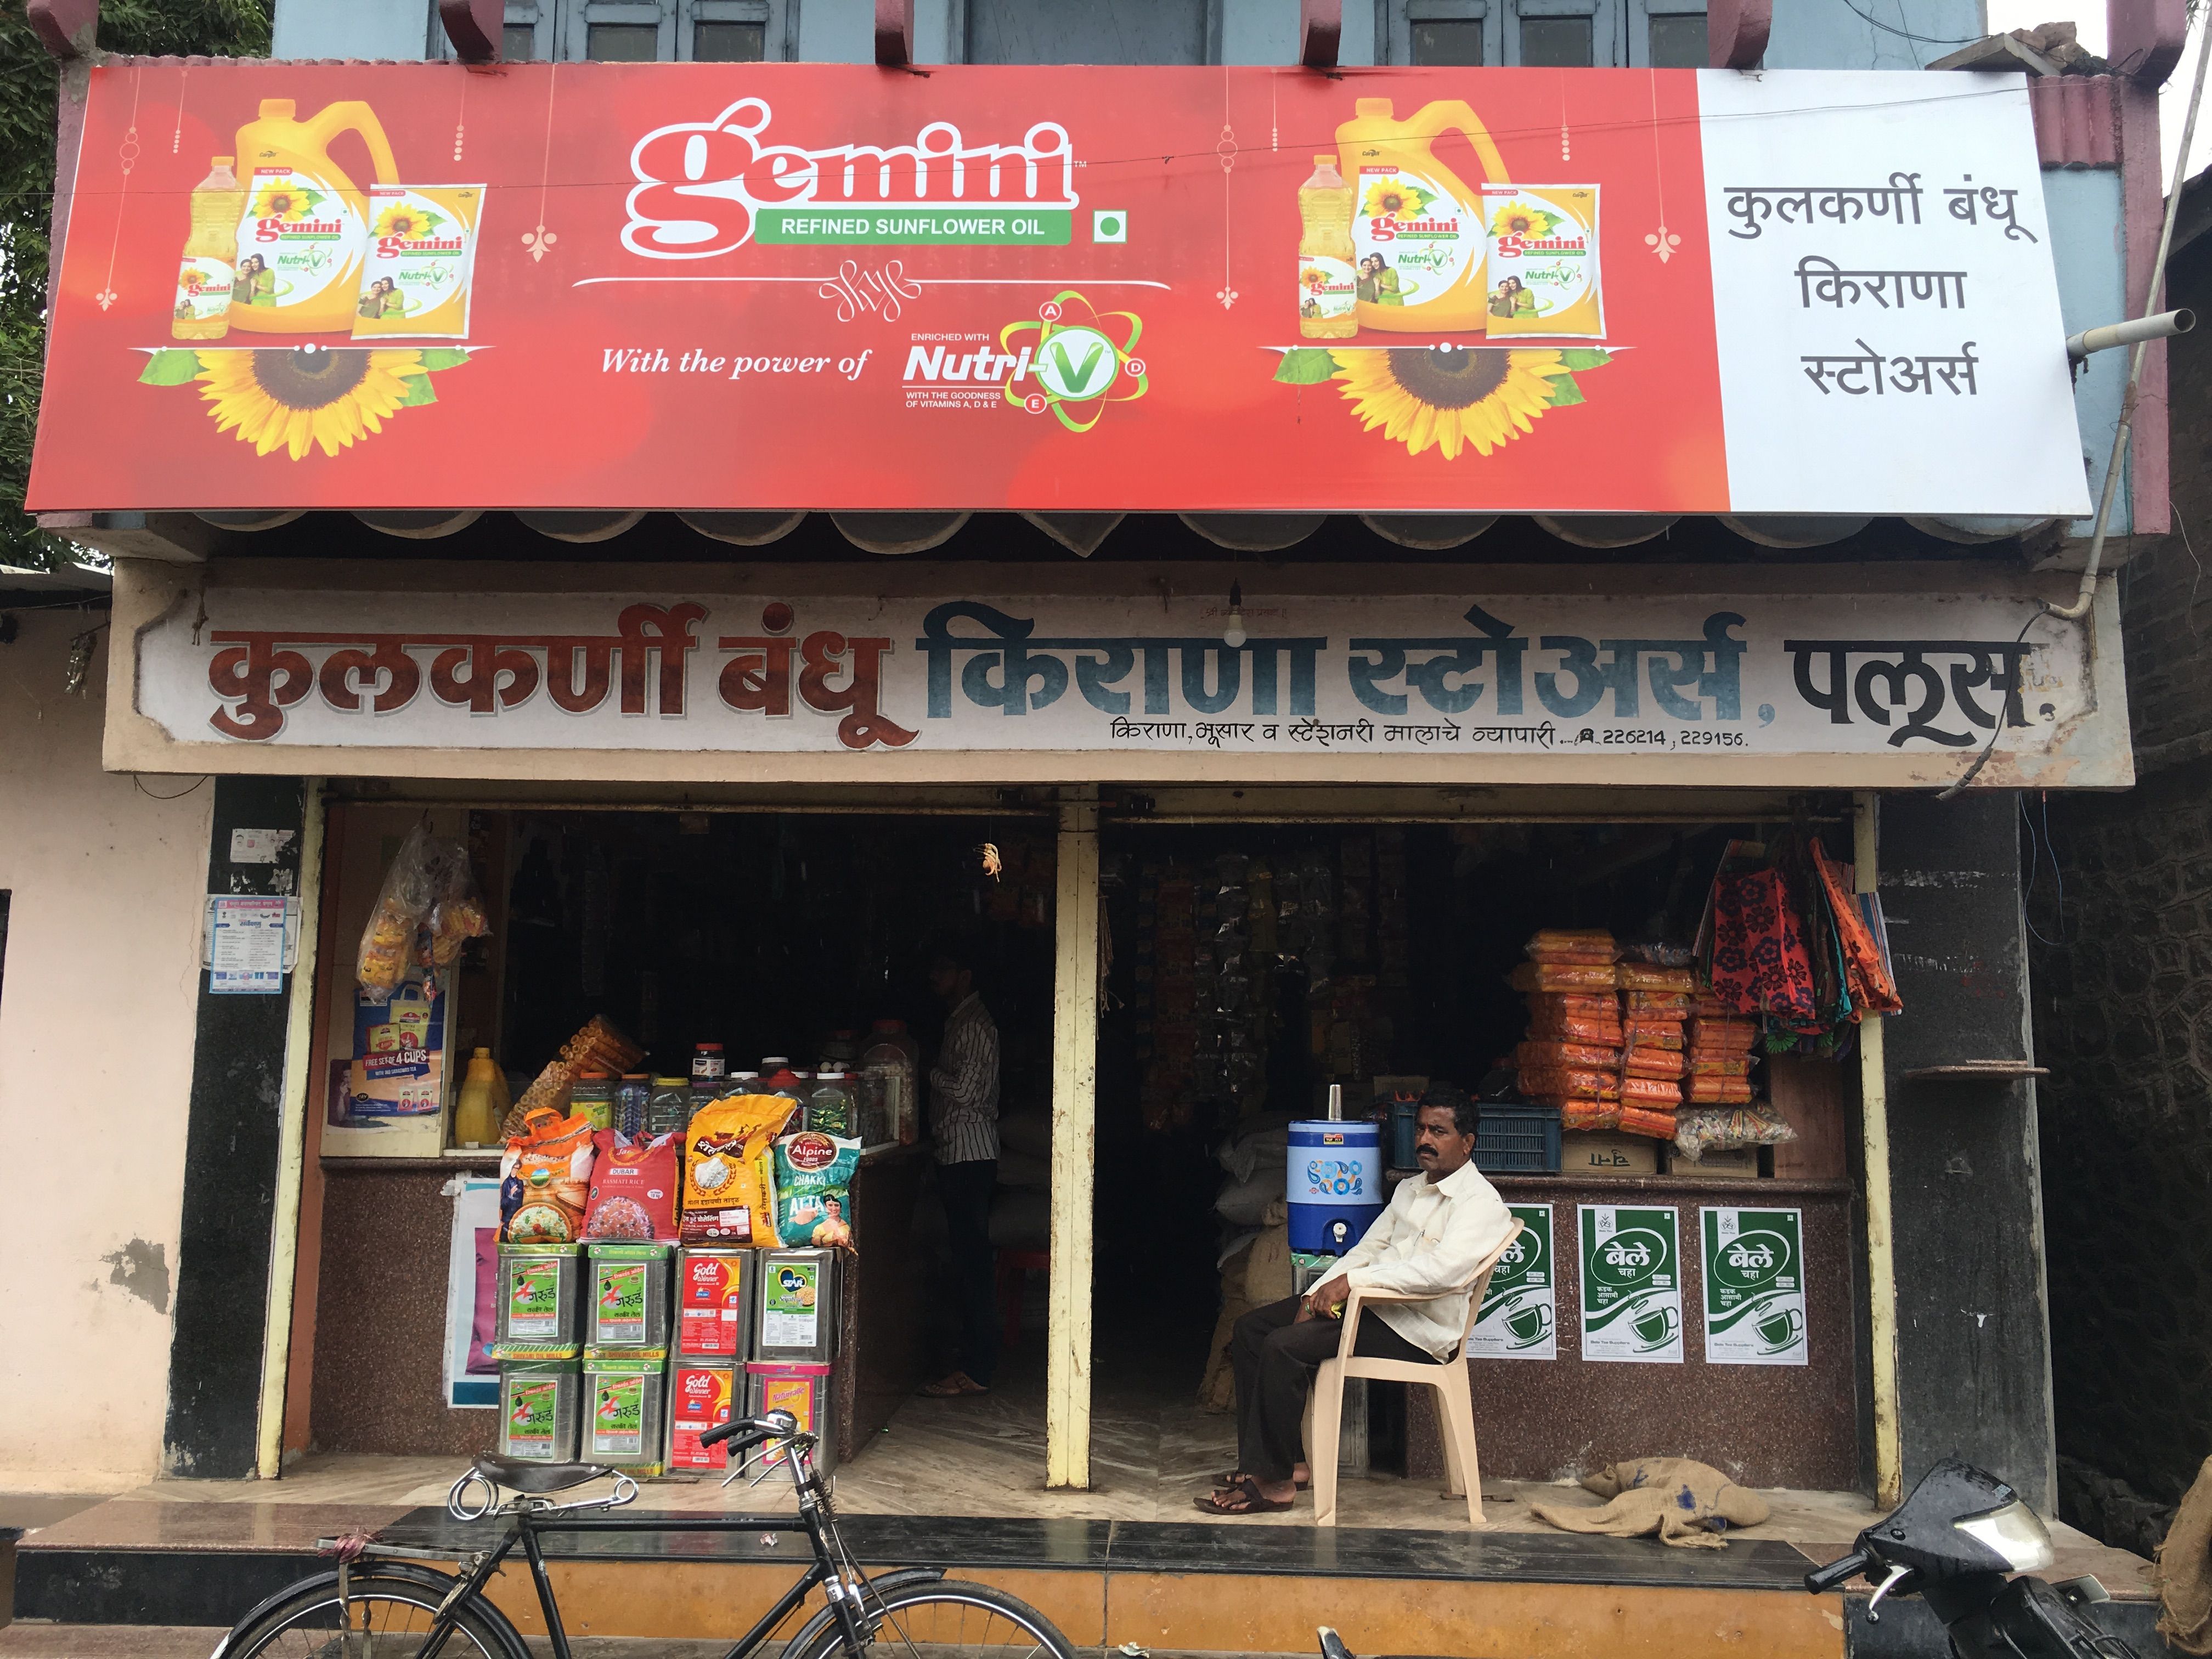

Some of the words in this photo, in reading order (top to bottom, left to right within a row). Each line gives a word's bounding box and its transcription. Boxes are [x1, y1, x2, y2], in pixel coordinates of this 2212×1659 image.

[620, 97, 1079, 259] gemini
[1724, 172, 1923, 240] कुलकर्णी
[1943, 174, 2038, 244] बंधू
[255, 214, 342, 242] gemini
[781, 218, 870, 235] REFINED
[875, 218, 1005, 235] SUNFLOWER
[1010, 218, 1045, 235] OIL
[1370, 212, 1459, 241] gemini
[376, 233, 462, 258] gemini
[1498, 232, 1585, 258] gemini
[1794, 255, 1968, 309] किराणा
[1044, 306, 1057, 317] A
[601, 348, 673, 374] With
[679, 348, 724, 374] the
[729, 354, 831, 380] power
[837, 348, 872, 380] of
[1131, 363, 1141, 373] D
[1801, 338, 1979, 396] स्टोअर्स
[931, 392, 949, 400] THE
[950, 392, 1001, 400] GOODNESS
[963, 400, 972, 409] A,
[1031, 399, 1039, 409] E
[208, 602, 711, 743] कुलकर्णी
[718, 602, 922, 751] बंधू
[915, 600, 1328, 718] किराणा
[1262, 724, 1280, 742] व
[1383, 718, 1462, 746] मालाचे
[365, 1057, 378, 1066] FREE
[396, 1052, 403, 1064] 4
[404, 1049, 427, 1064] CUPS
[792, 1144, 833, 1157] Alpine
[794, 1174, 826, 1187] CHAKKI
[789, 1195, 825, 1216] ATTA
[1604, 1241, 1651, 1266] बेले
[1727, 1243, 1774, 1268] बेले
[693, 1263, 719, 1281] Gold
[1617, 1268, 1636, 1278] चहा
[1740, 1270, 1760, 1281] चहा
[783, 1278, 804, 1288] STAR
[685, 1375, 711, 1393] Gold
